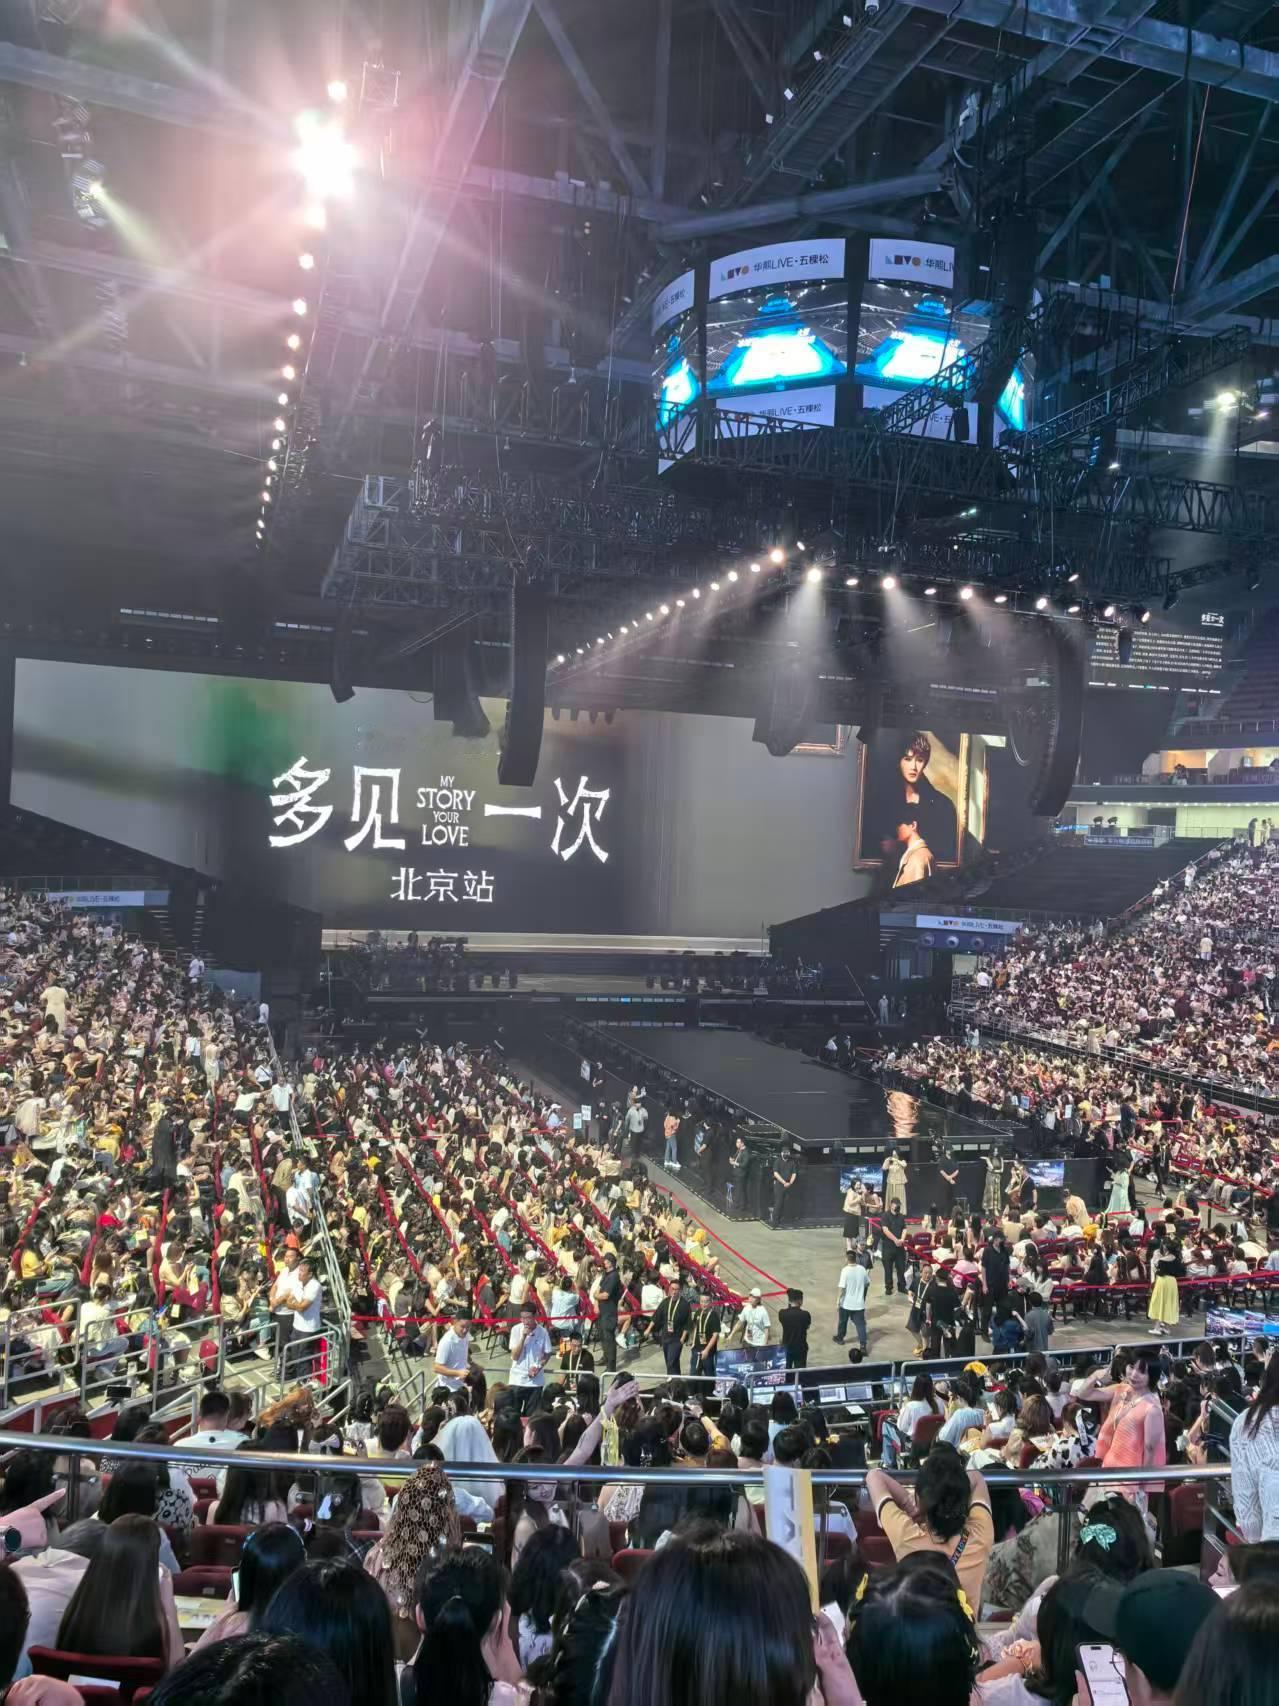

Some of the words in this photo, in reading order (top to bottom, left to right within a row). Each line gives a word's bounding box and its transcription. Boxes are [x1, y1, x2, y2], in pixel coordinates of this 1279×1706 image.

[440, 775, 455, 788] MY
[269, 756, 405, 851] 多见
[484, 775, 610, 863] 一次
[416, 788, 477, 810] STORY
[433, 810, 460, 824] YOUR
[421, 823, 469, 847] LOVE
[390, 867, 495, 902] 北京站
